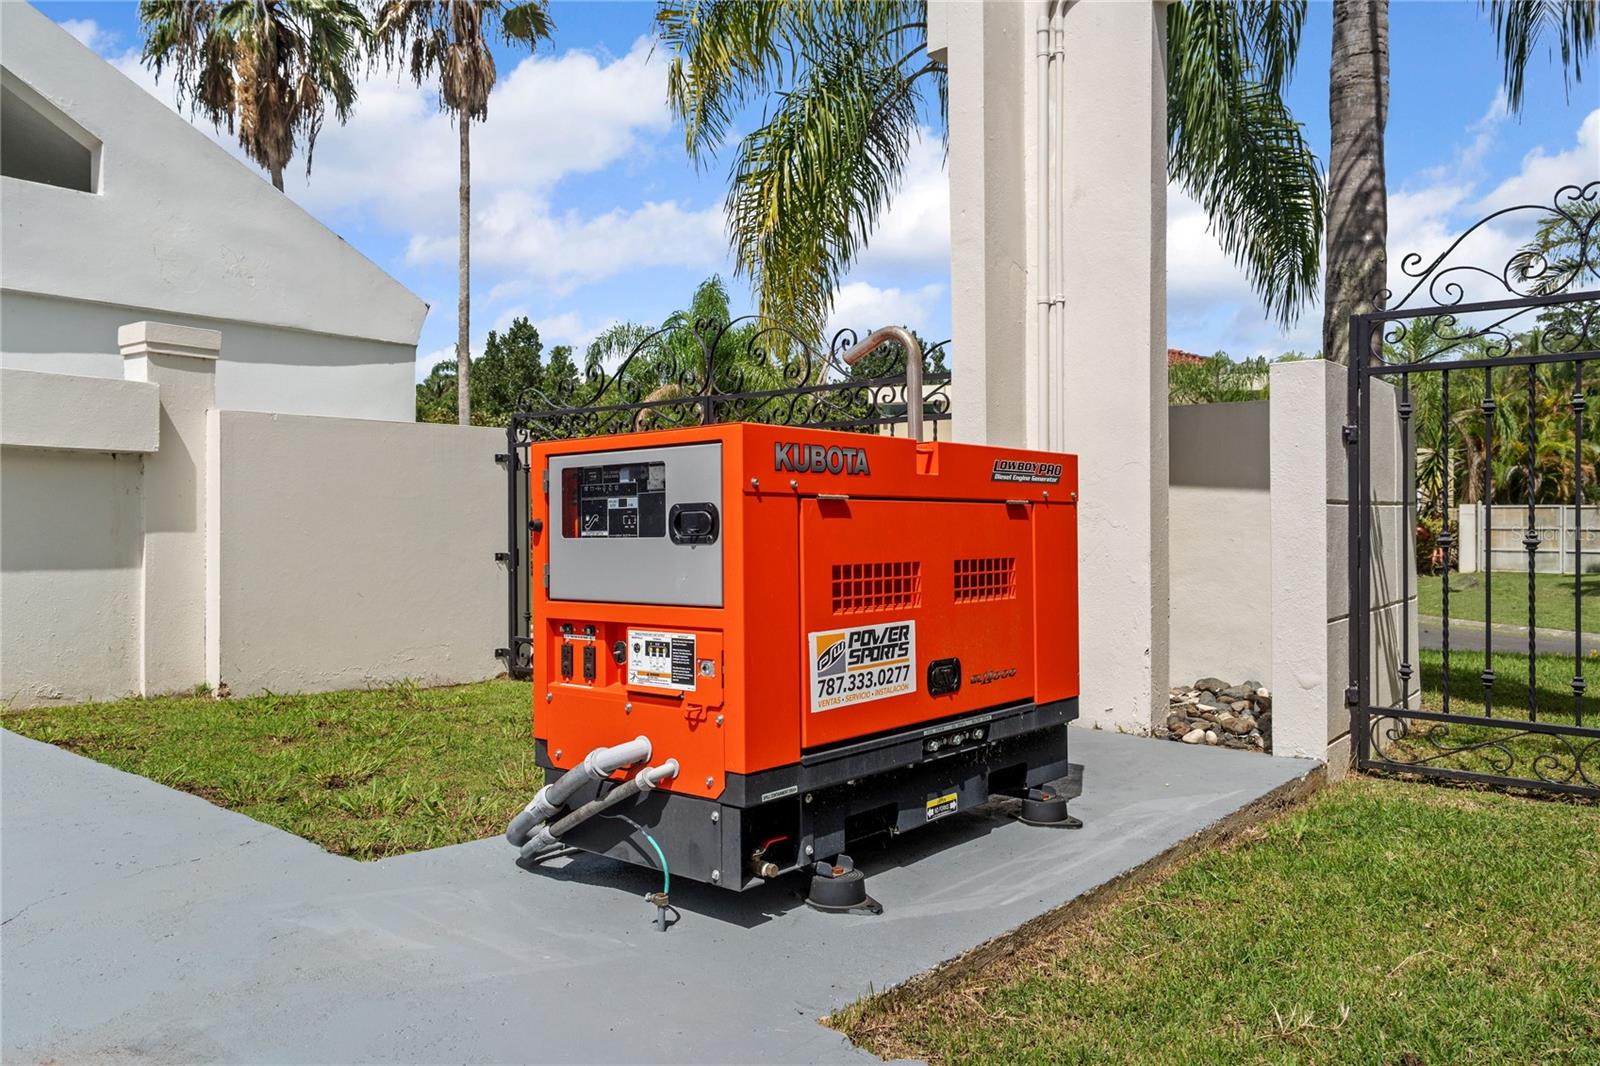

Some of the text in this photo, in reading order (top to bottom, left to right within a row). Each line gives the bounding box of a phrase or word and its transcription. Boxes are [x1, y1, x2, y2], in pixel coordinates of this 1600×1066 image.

[775, 442, 870, 475] KUBOTA
[993, 460, 1063, 476] LOWBOY PRO
[1012, 474, 1031, 482] Engine
[848, 625, 910, 648] POWER
[848, 641, 910, 665] SPORTS
[817, 664, 910, 698] 787.333.0277
[817, 696, 841, 707] VENTAS
[845, 691, 871, 702] SERVICIO
